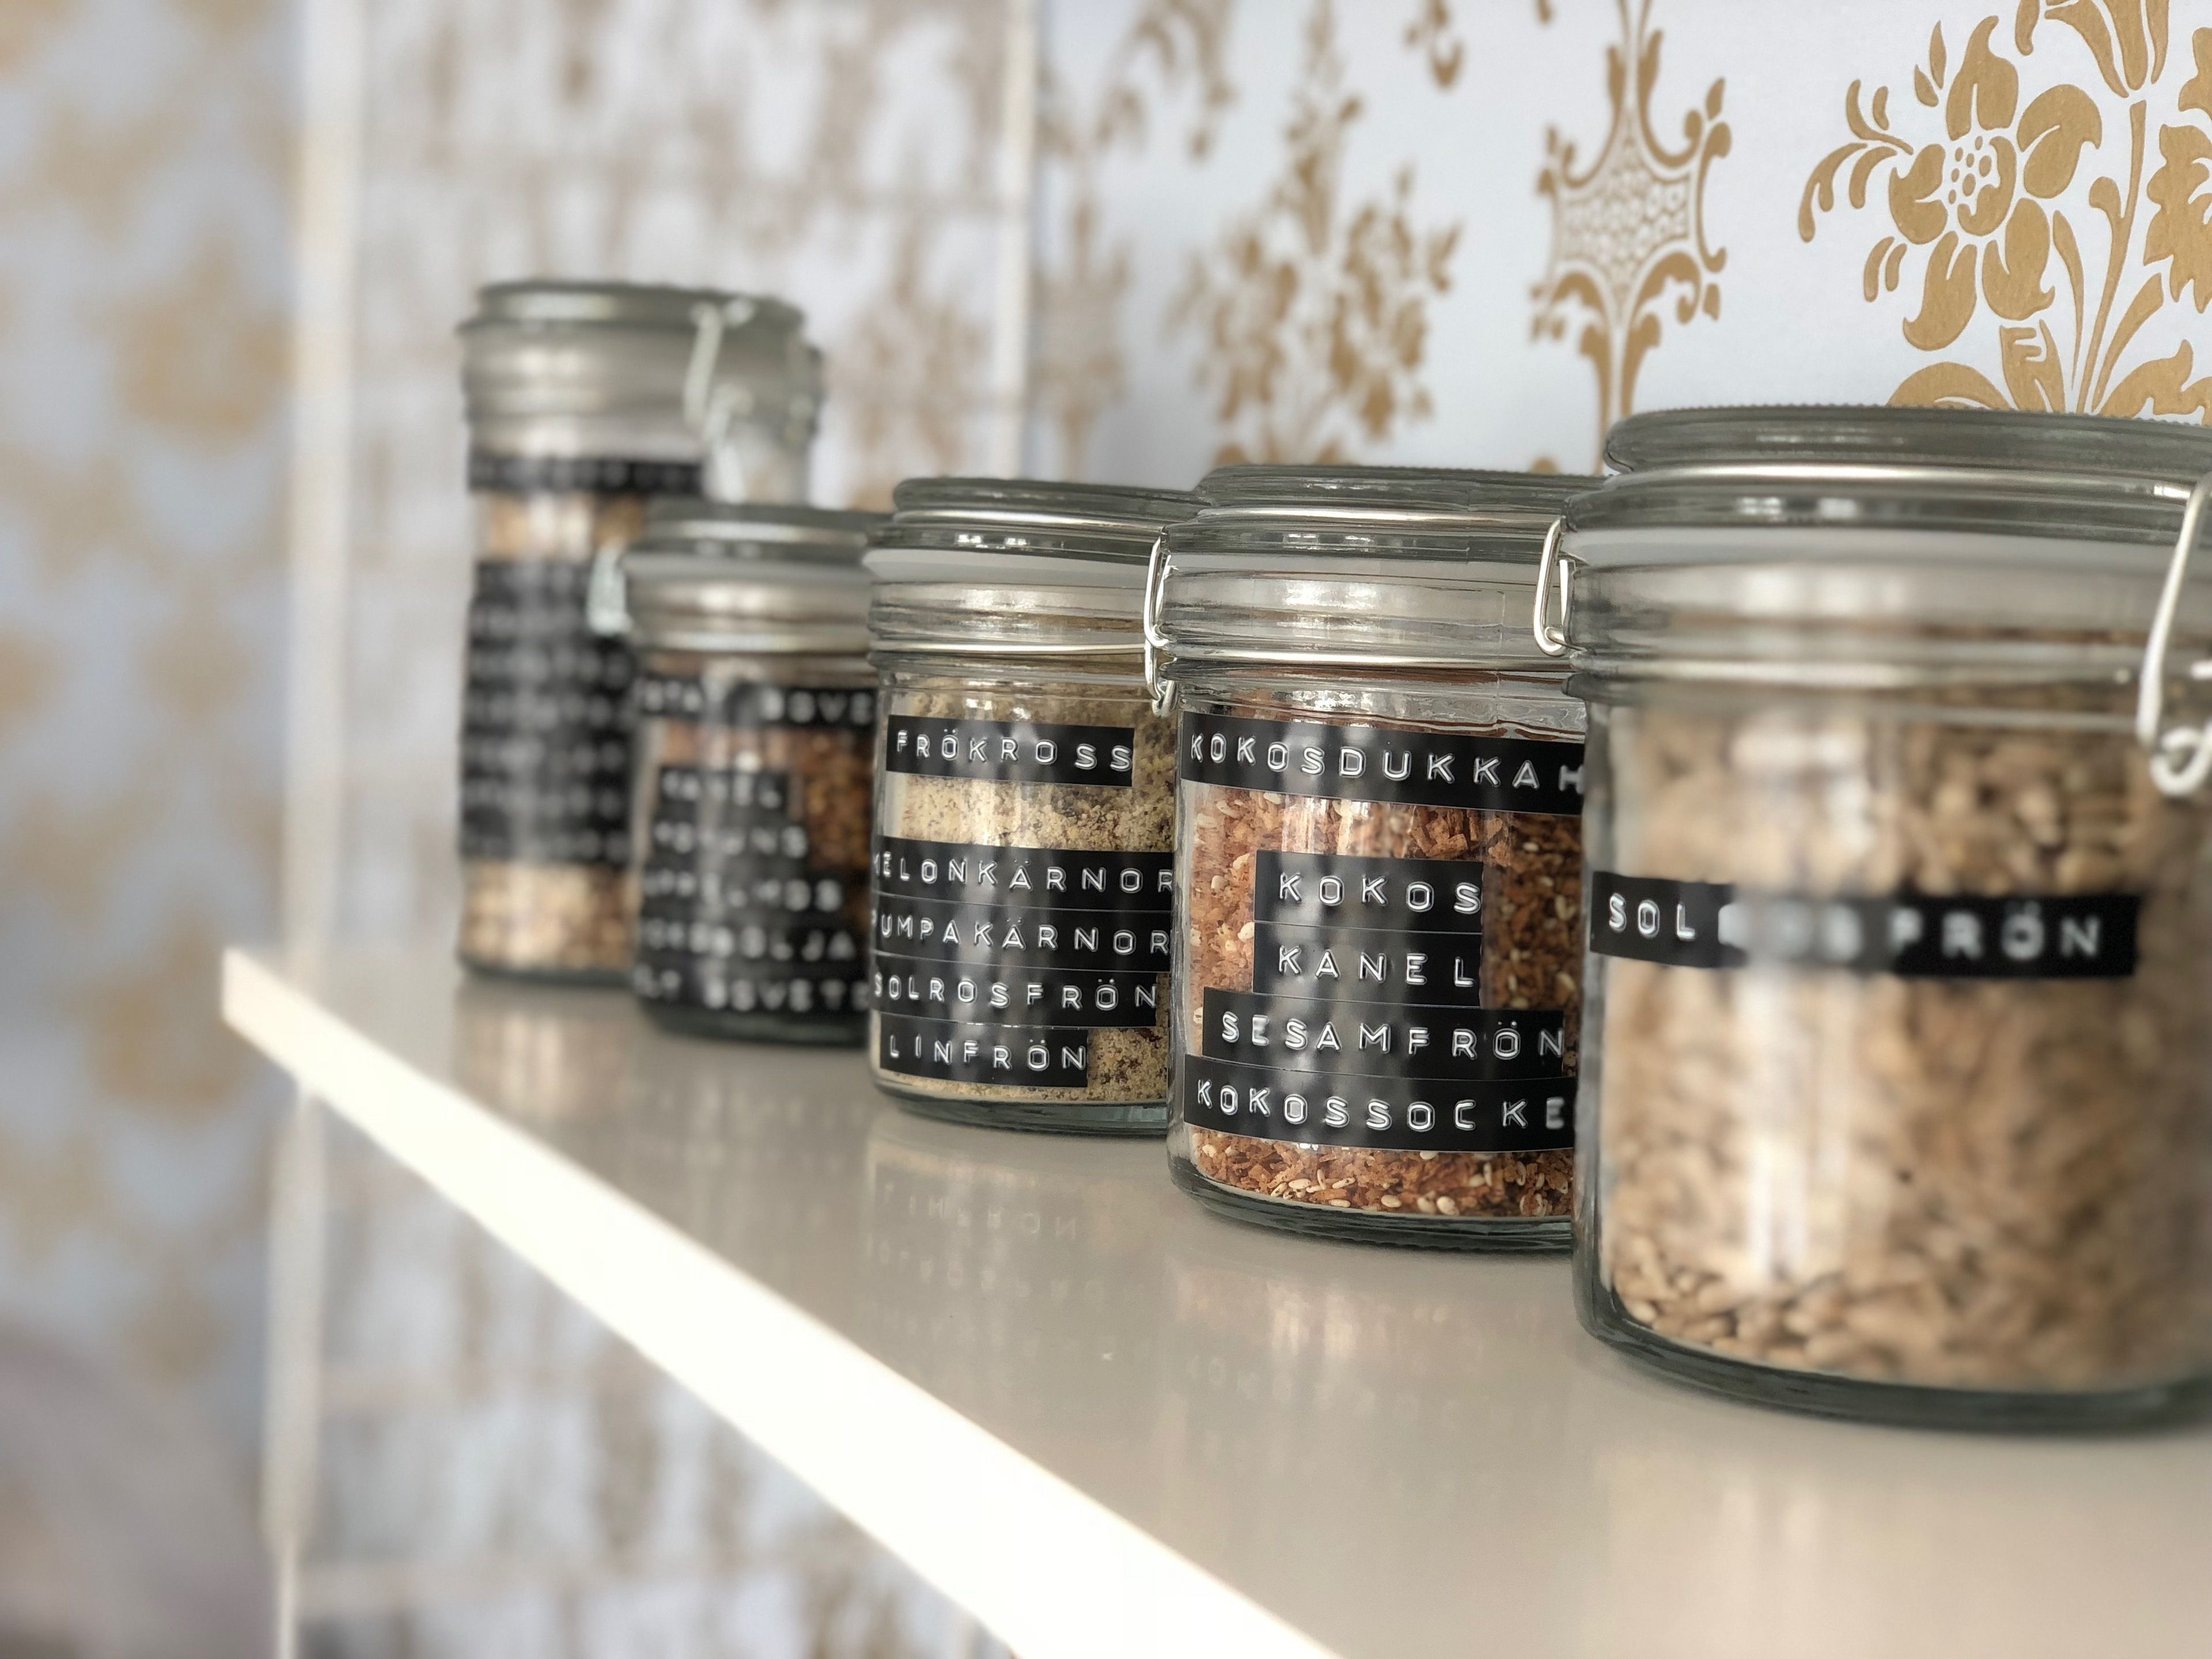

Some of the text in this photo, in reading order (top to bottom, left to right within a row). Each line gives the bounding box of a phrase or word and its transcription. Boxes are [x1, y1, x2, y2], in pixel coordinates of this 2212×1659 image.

[896, 728, 1133, 772] FRÖKROSS
[1190, 732, 1585, 794] KOKOSDUKKAH
[1278, 871, 1482, 914] KOKOS
[1607, 892, 2102, 962] SOLFRÖN
[1278, 945, 1475, 987] KANEL
[874, 972, 1157, 1010] SOLROSFRÖN
[889, 1035, 1087, 1071] LINFRÖN
[1221, 1012, 1565, 1060] SESAMFRÖN
